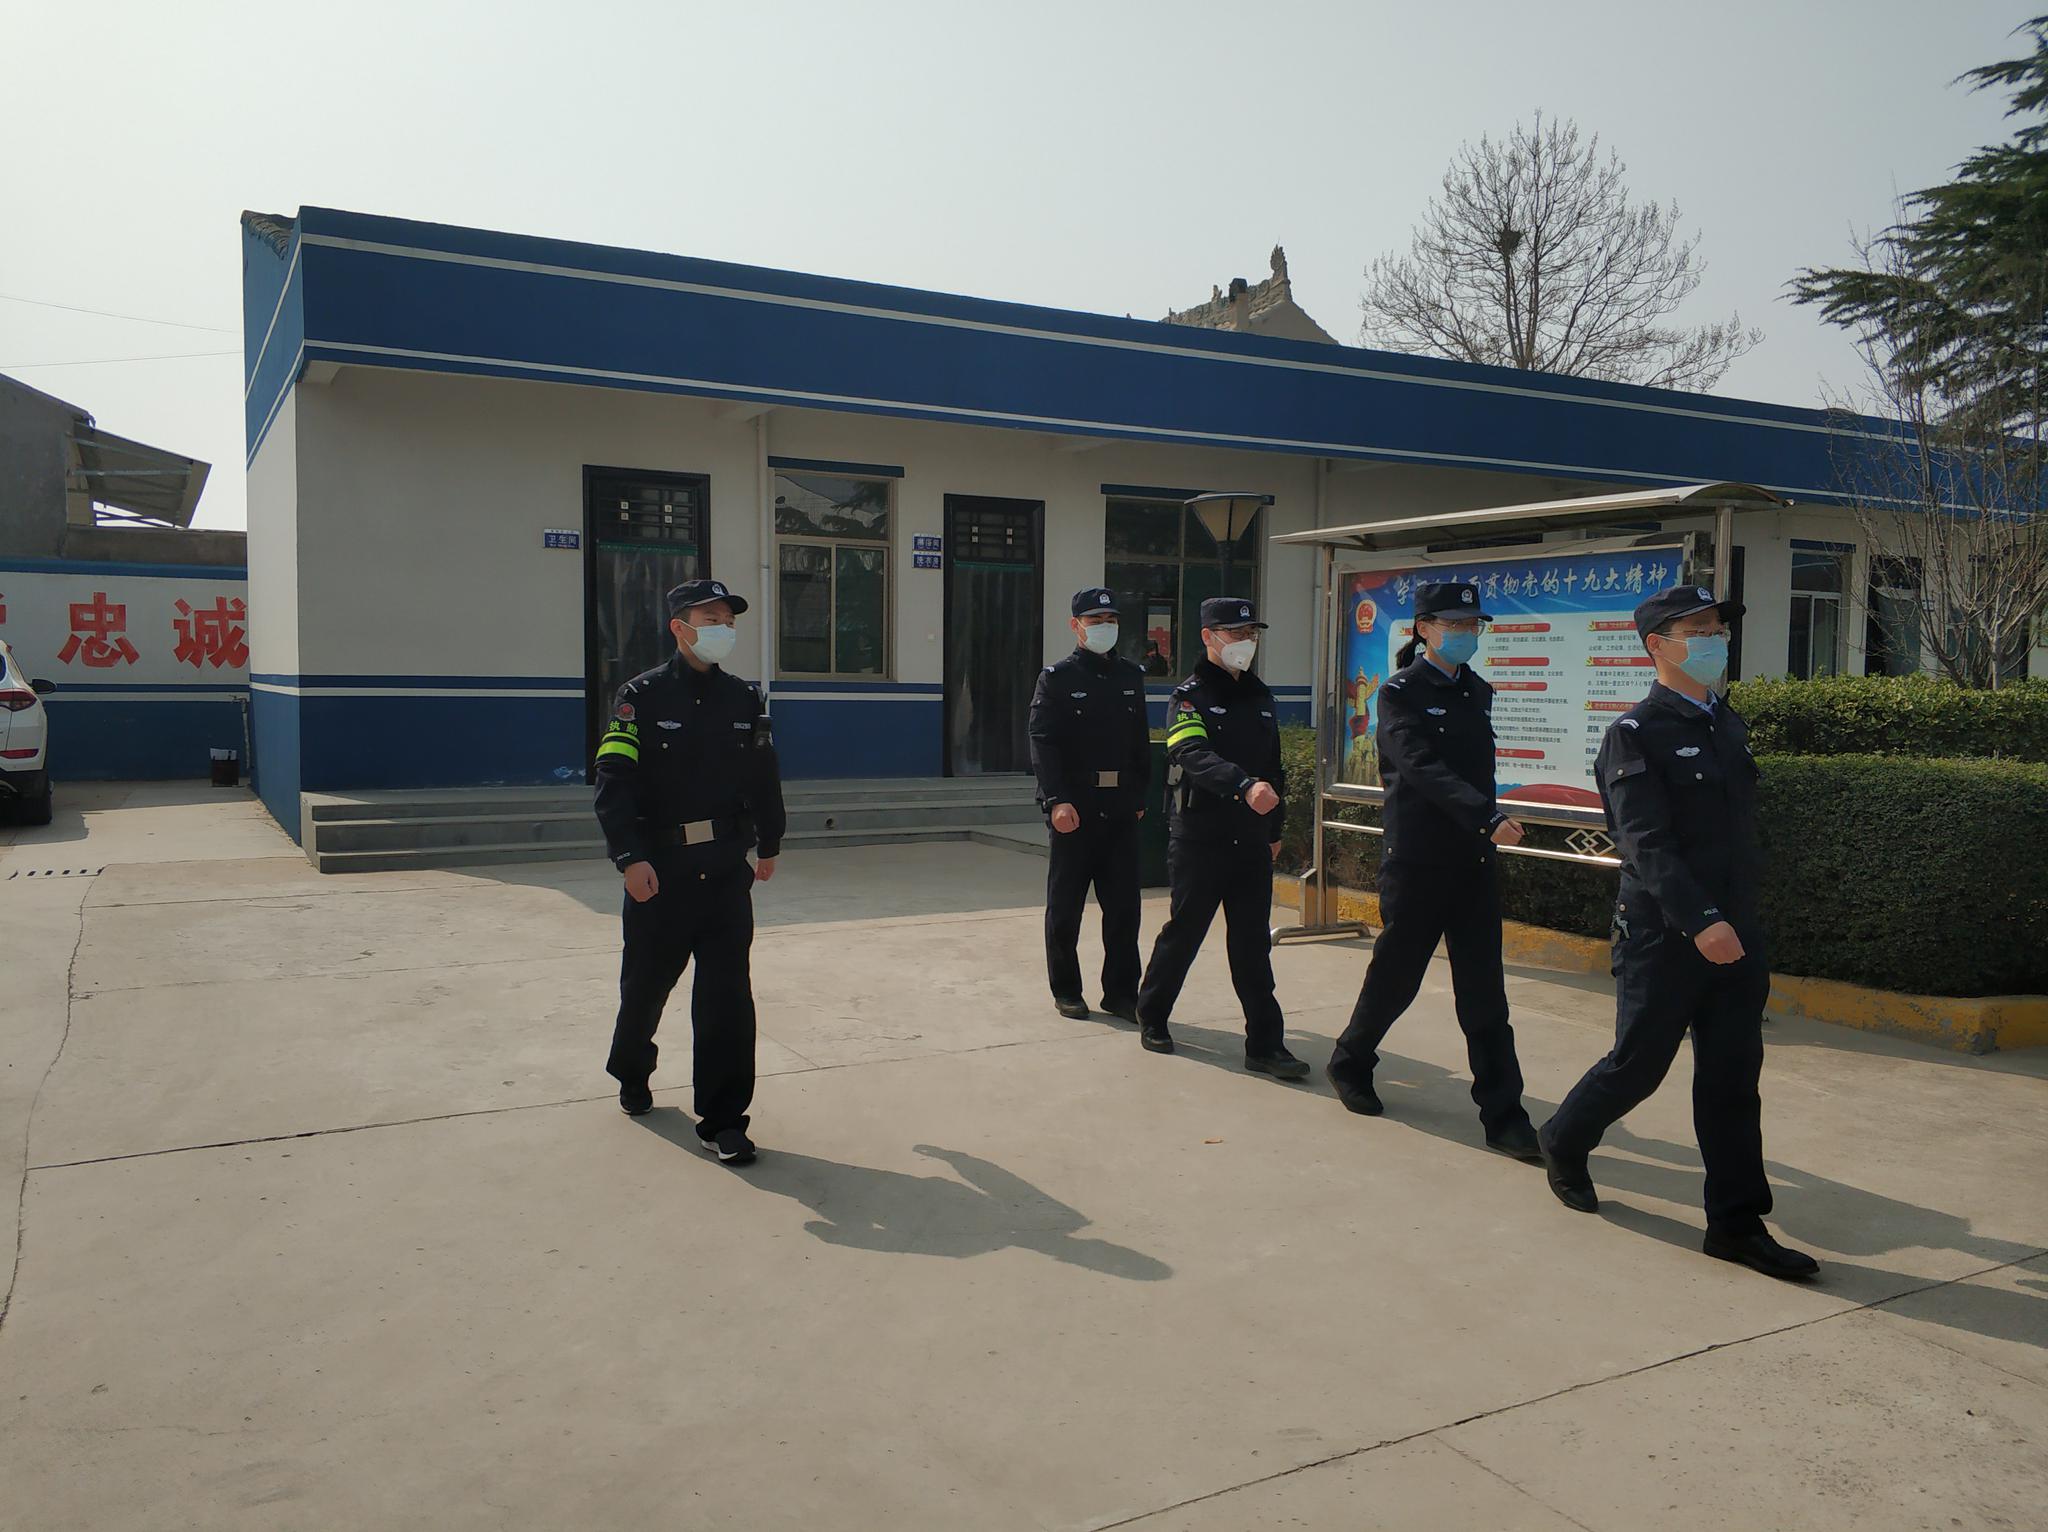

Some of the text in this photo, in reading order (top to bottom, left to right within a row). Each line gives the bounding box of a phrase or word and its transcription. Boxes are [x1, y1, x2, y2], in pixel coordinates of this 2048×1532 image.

[1396, 562, 1668, 608] 学贯彻党的十九大精神
[608, 720, 639, 736] 执勤
